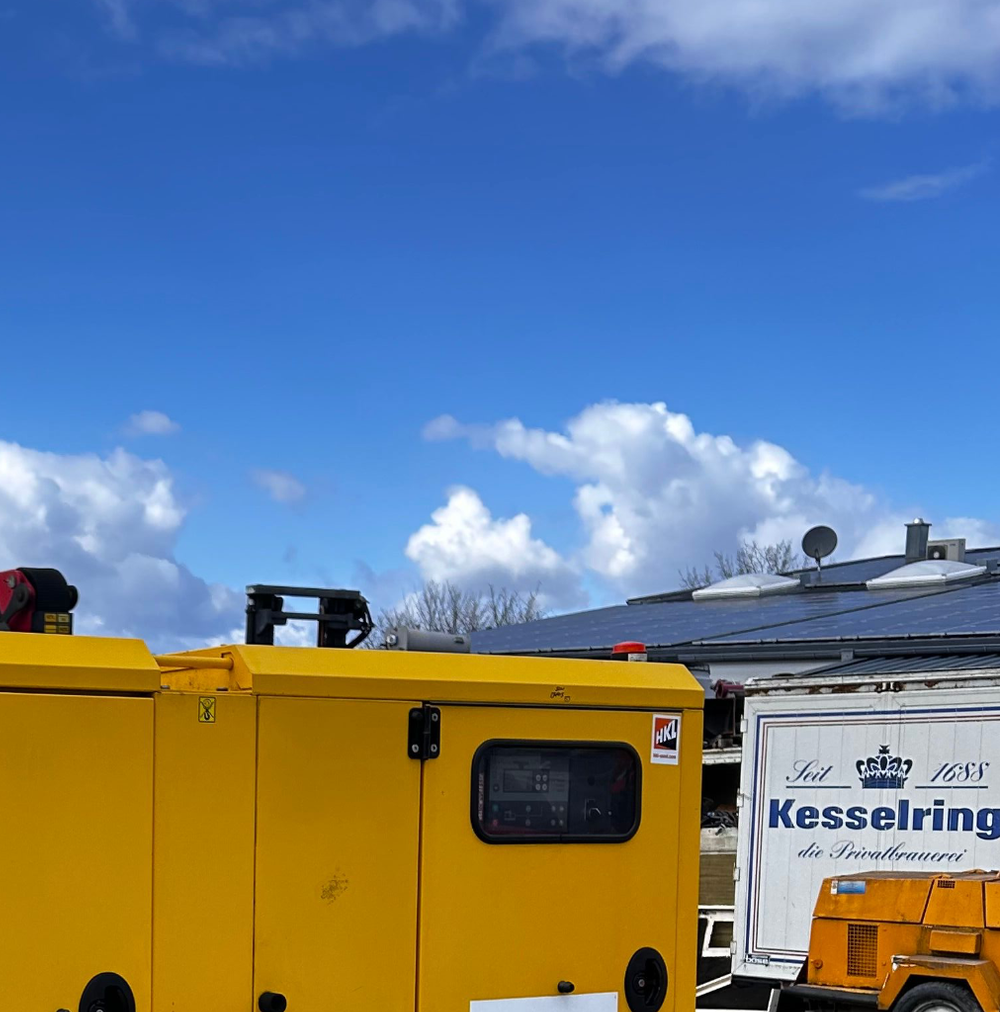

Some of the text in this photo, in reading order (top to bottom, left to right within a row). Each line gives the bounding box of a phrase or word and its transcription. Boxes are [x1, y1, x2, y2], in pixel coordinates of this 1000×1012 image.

[655, 719, 677, 745] HKL
[785, 759, 990, 783] Seit 1688
[768, 798, 1000, 841] Kesselring
[797, 840, 968, 863] die Privatbrauerei
